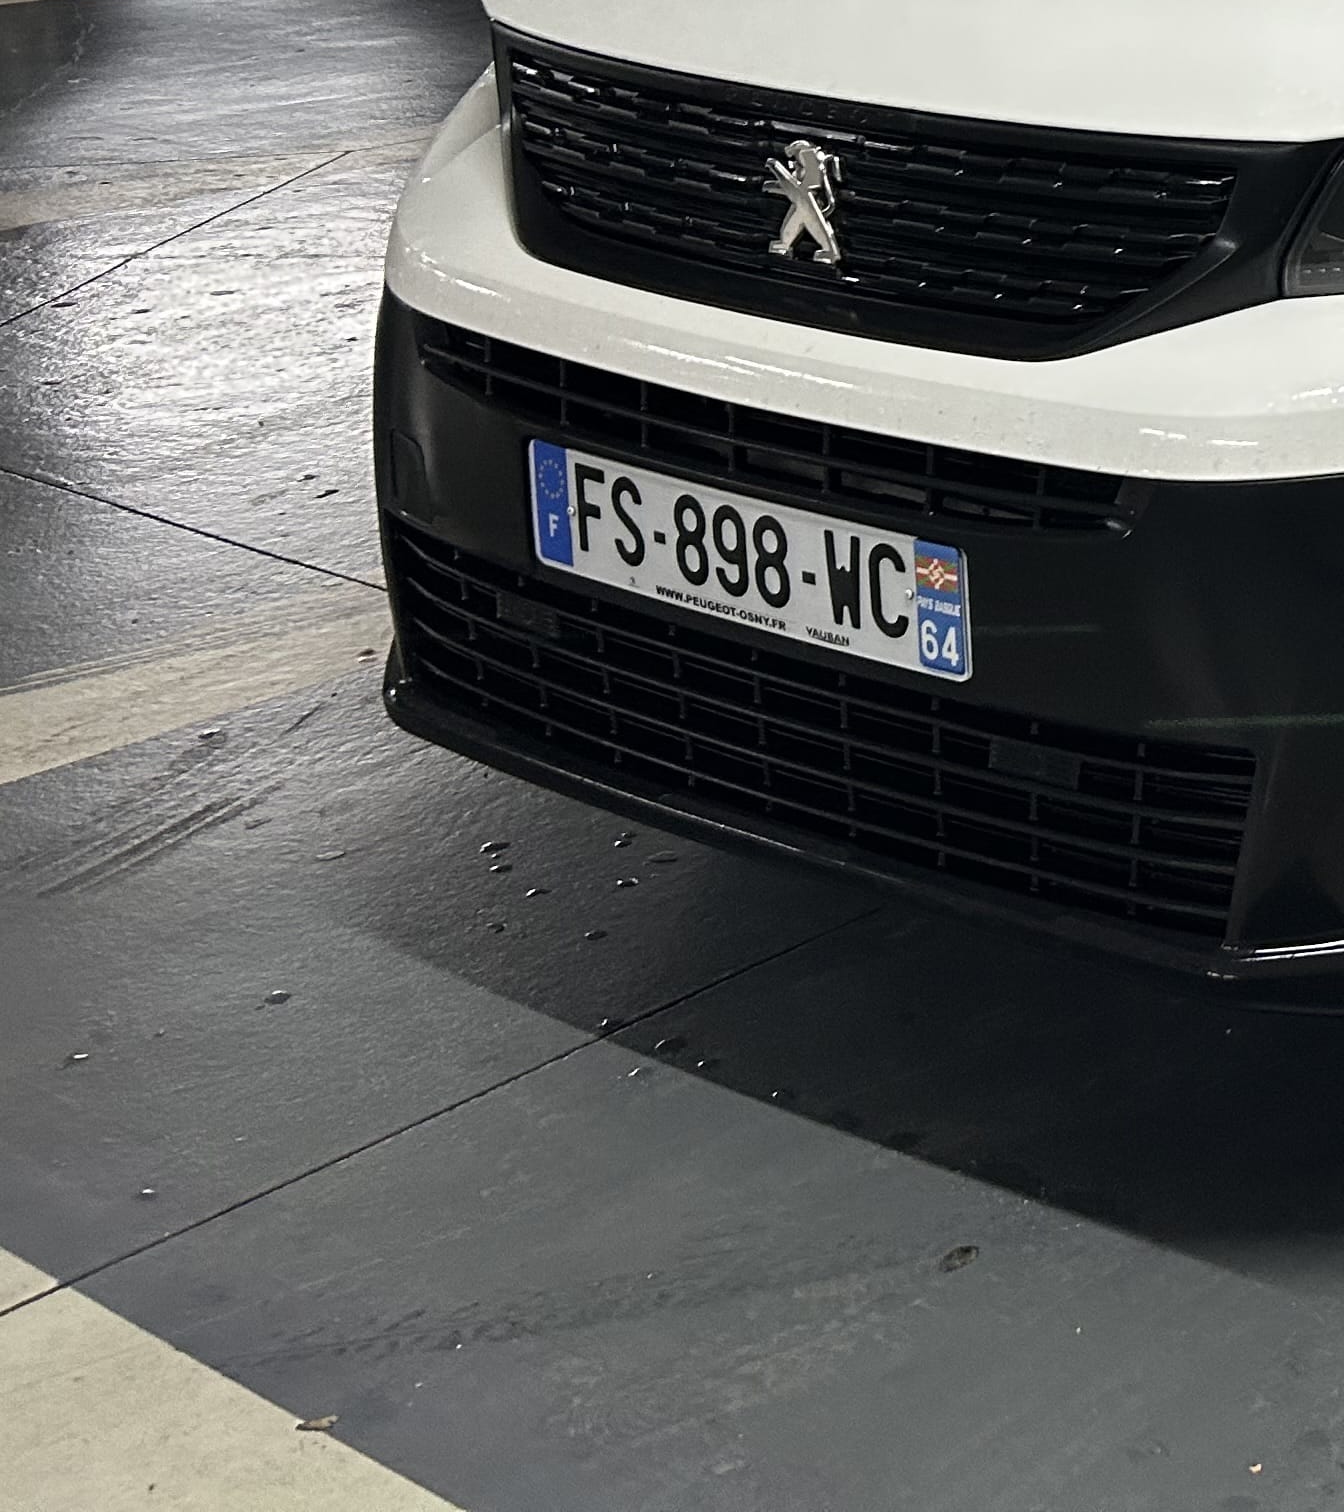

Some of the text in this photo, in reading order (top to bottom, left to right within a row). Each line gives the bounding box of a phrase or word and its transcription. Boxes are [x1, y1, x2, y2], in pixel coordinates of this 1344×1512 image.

[549, 513, 559, 537] F
[574, 463, 910, 638] FS-898-WC
[656, 585, 786, 631] WWW.PEUGEOT-OSNY.FR
[921, 619, 959, 667] 64
